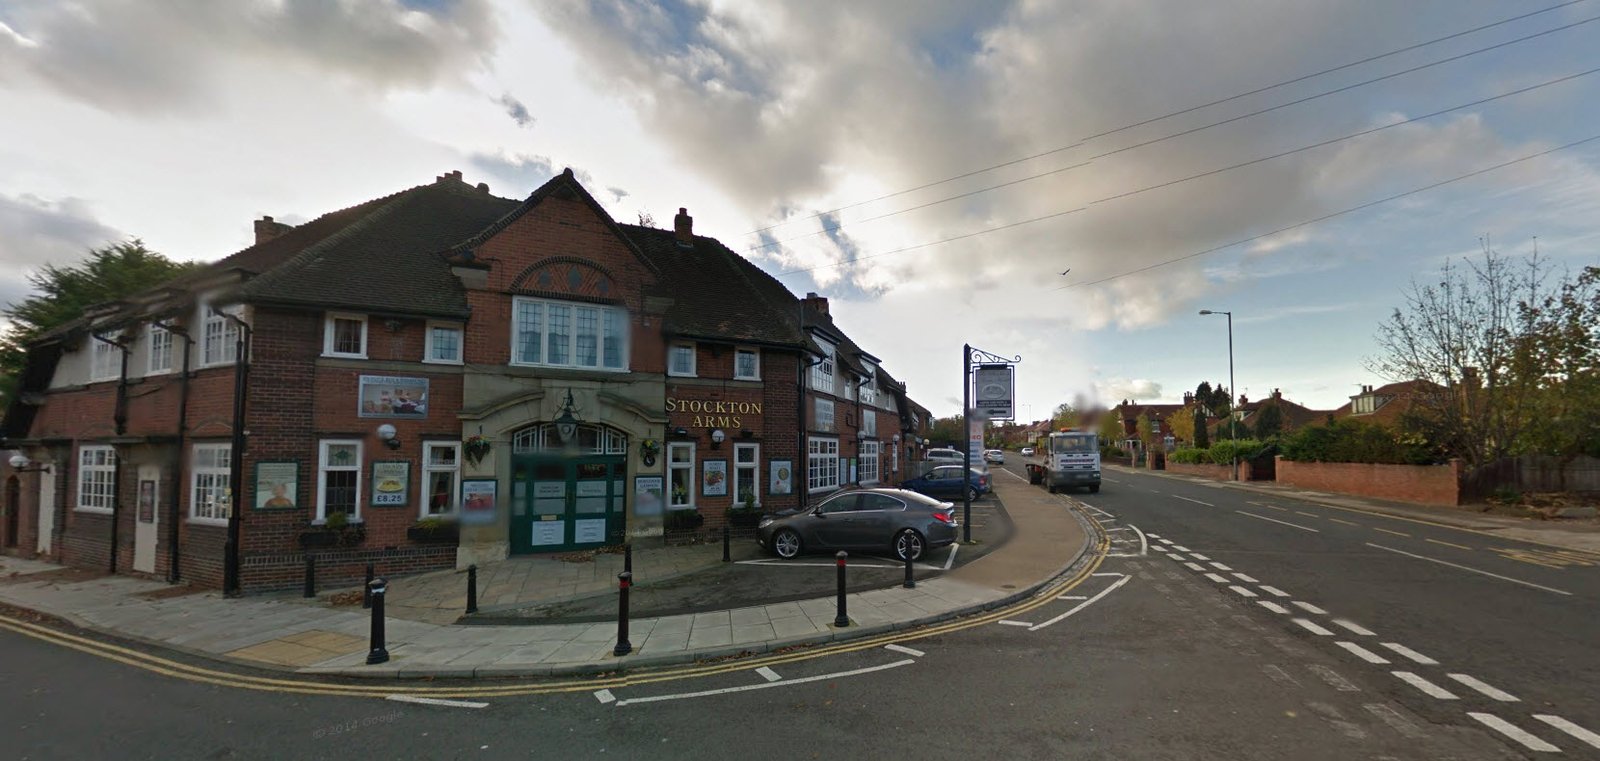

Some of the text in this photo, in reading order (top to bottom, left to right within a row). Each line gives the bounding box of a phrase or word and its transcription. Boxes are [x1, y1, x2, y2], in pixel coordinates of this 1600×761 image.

[665, 397, 762, 415] STOCKTON
[692, 415, 742, 429] ARMS
[377, 494, 402, 503] £8.25
